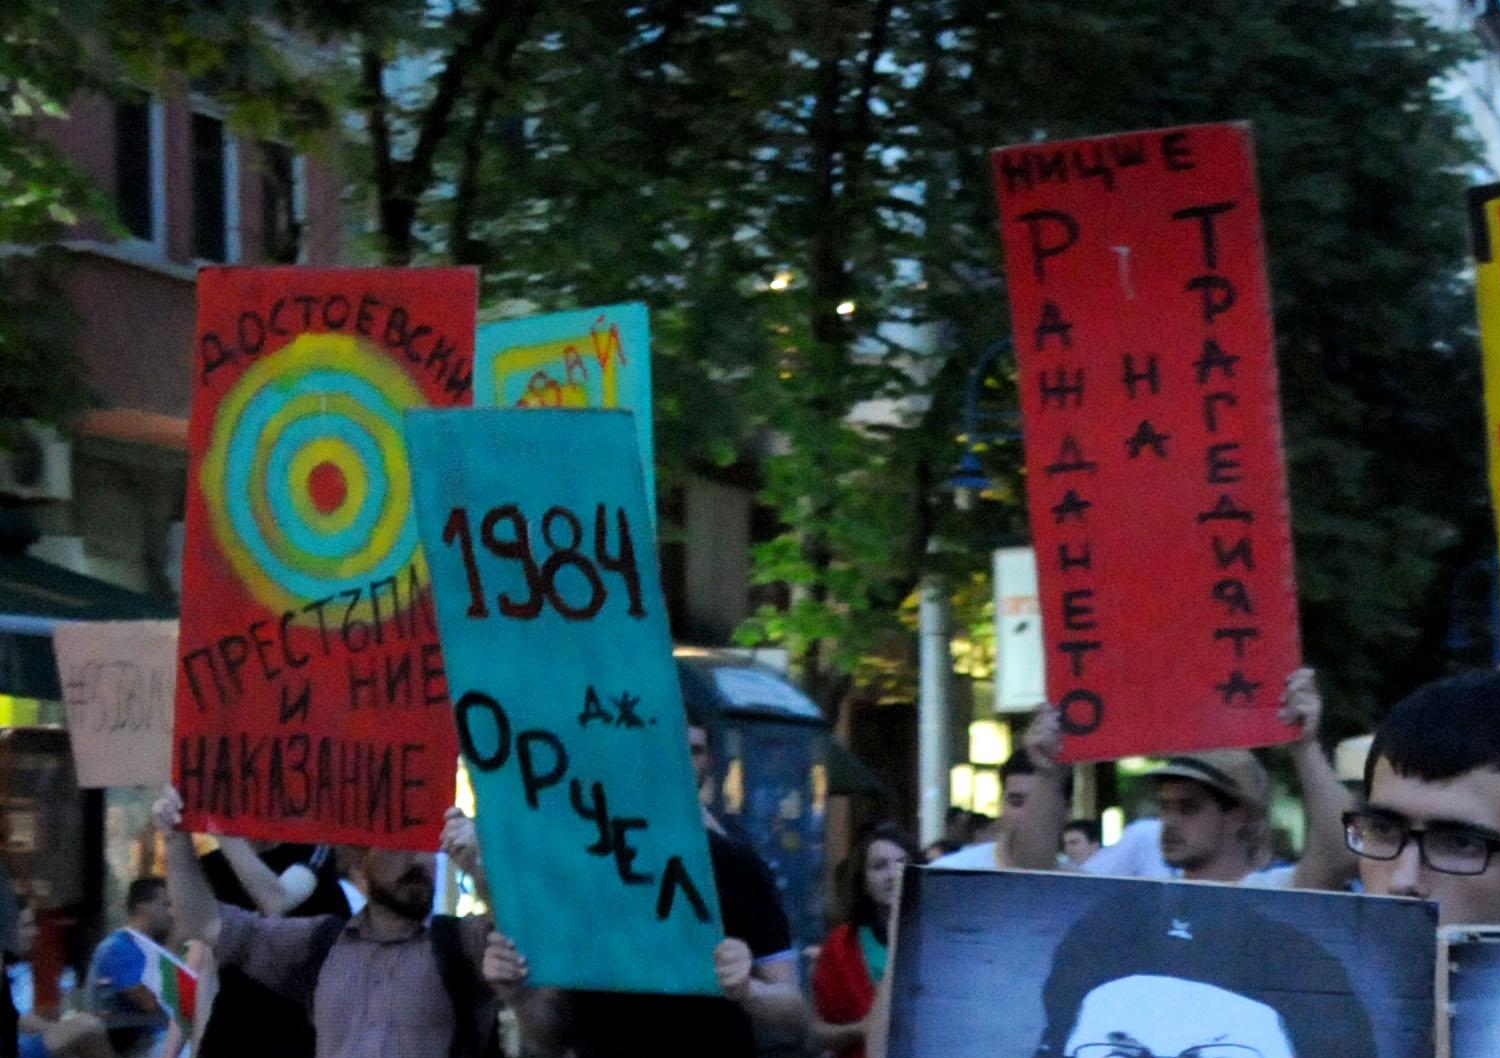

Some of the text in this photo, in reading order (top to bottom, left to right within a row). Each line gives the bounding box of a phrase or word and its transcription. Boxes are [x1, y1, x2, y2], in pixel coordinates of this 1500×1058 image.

[1003, 131, 1197, 194] НИЦШЕ
[1121, 352, 1172, 460] НА
[1172, 200, 1263, 705] ТРАГЕДИЯТА
[1018, 209, 1104, 737] РАЖДАНЕТО
[442, 504, 648, 621] 1984
[278, 678, 312, 725] И
[577, 684, 659, 729] ДЖ.
[180, 732, 428, 835] НАКАЗАНИЕ
